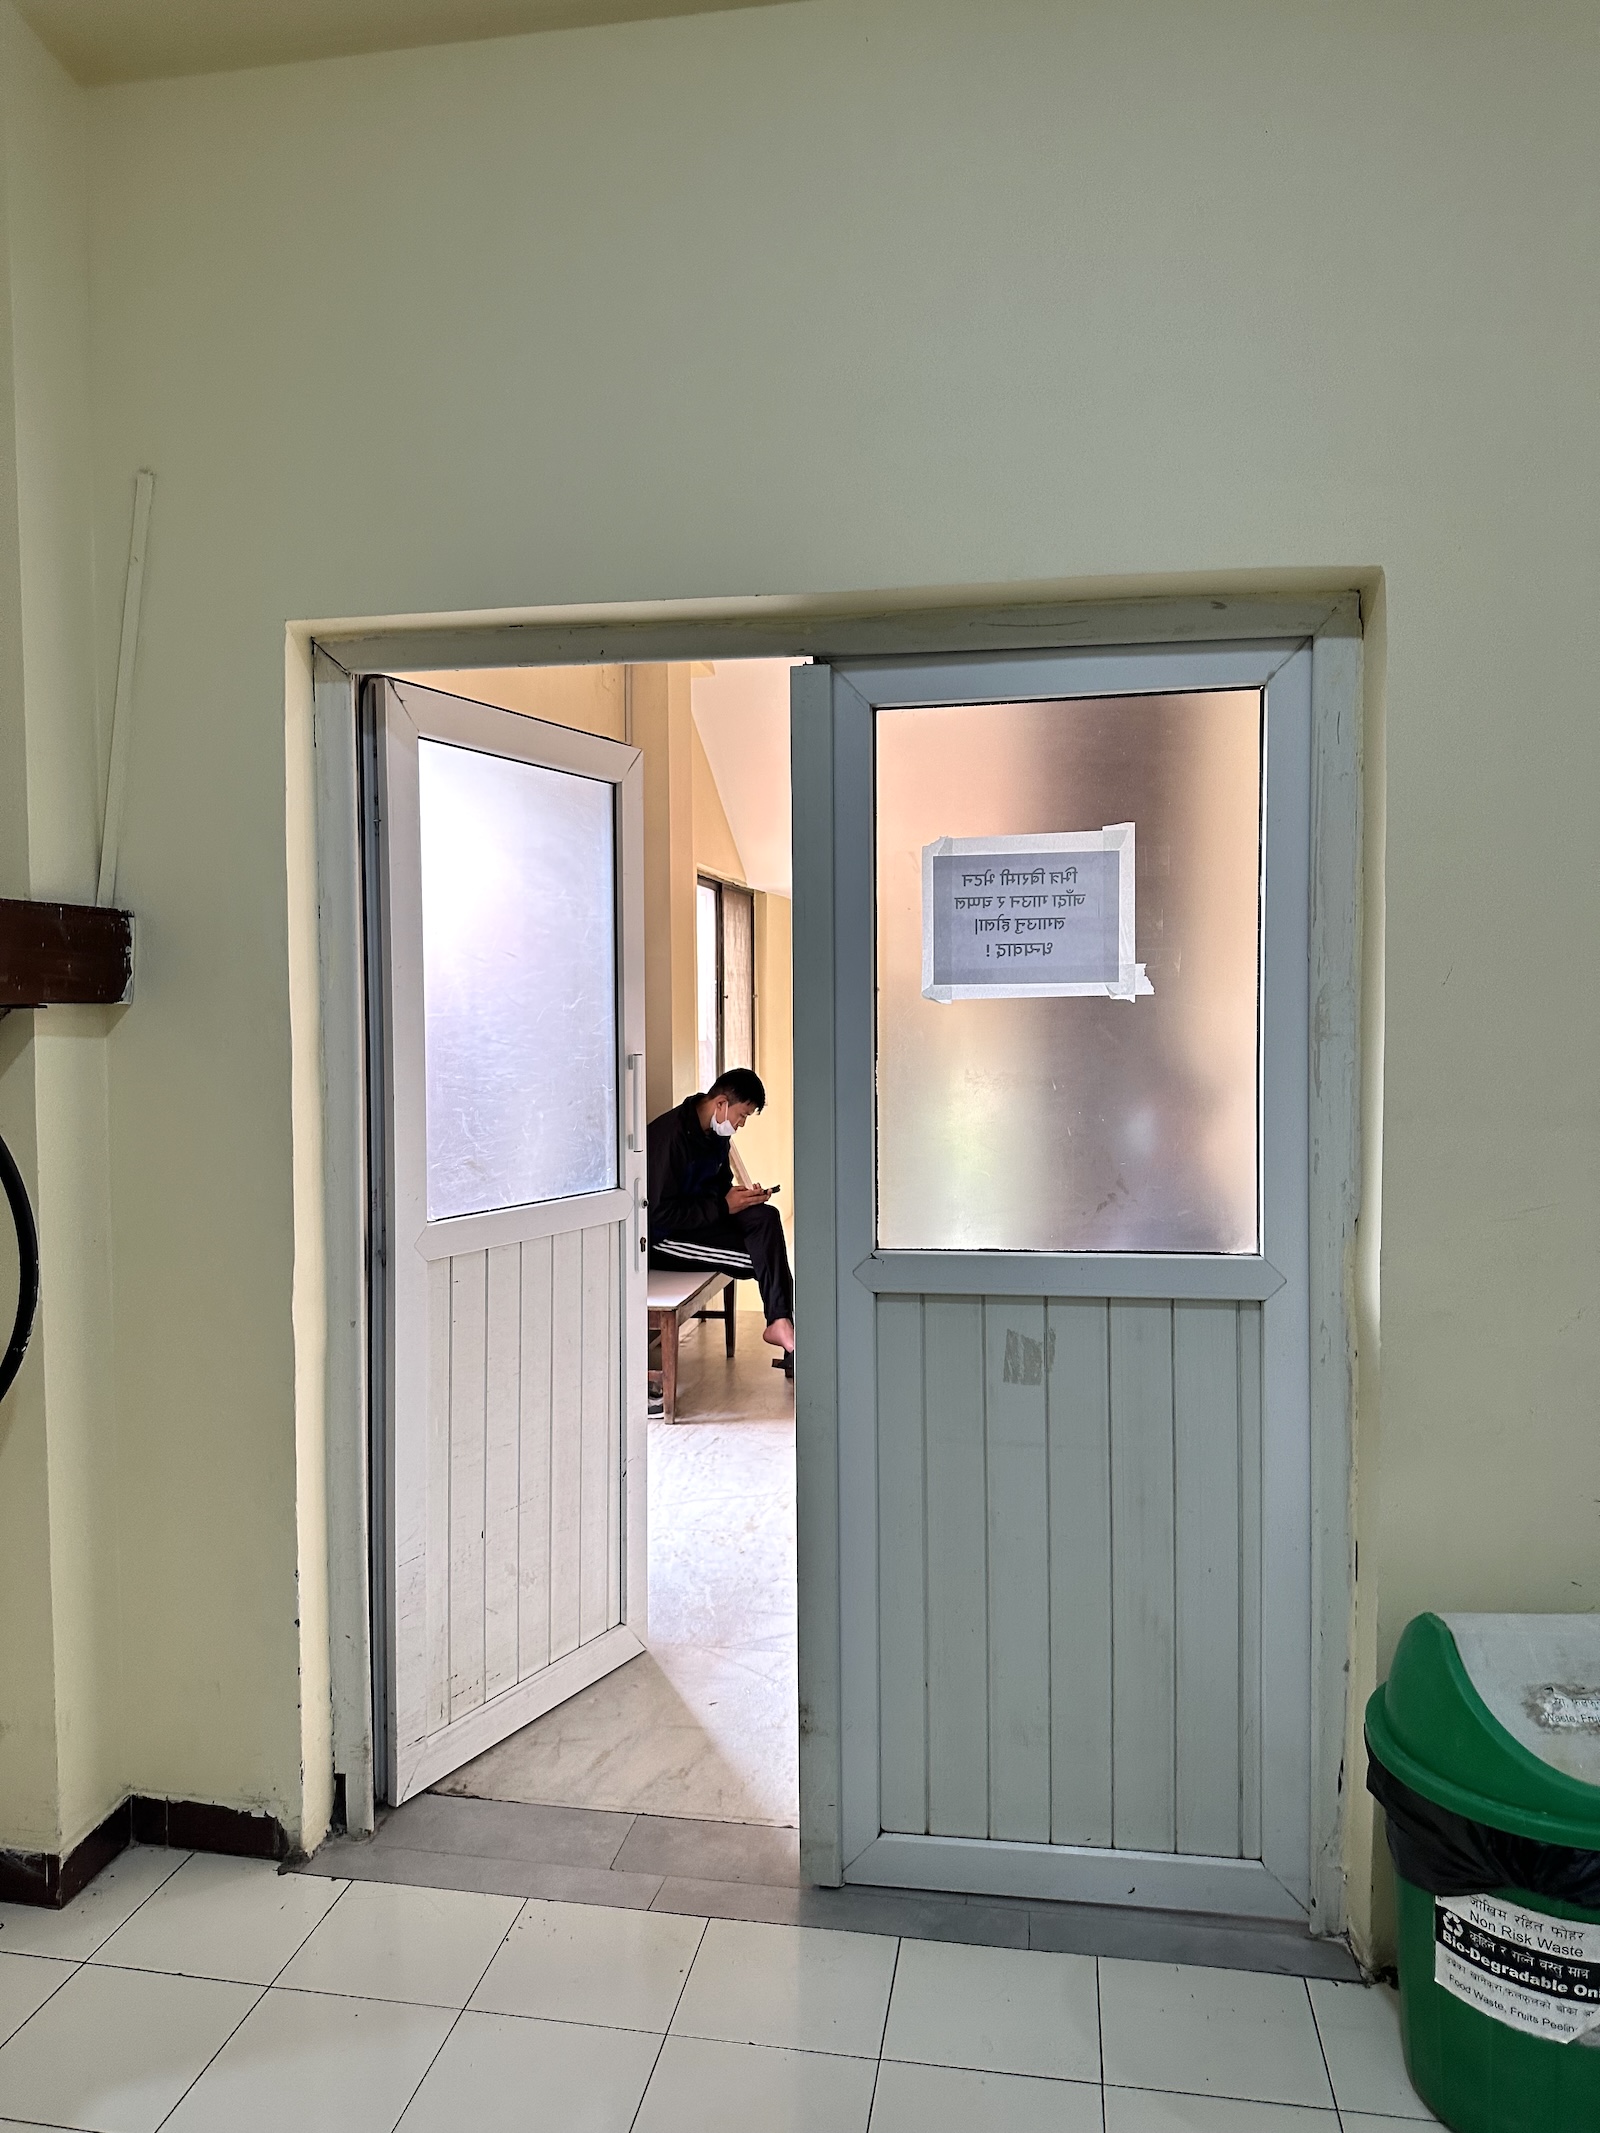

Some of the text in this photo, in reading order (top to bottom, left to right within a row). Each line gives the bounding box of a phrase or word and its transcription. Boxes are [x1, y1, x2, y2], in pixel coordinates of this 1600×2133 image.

[1470, 1910, 1584, 1957] Non Risk Waste
[1514, 1914, 1544, 1933] रहित
[1551, 1925, 1585, 1941] फोहर
[1443, 1929, 1600, 1999] Bio-Degradable On
[1450, 1974, 1471, 1994] Food
[1473, 1989, 1507, 2014] Waste,
[1510, 2007, 1539, 2024] Fruits
